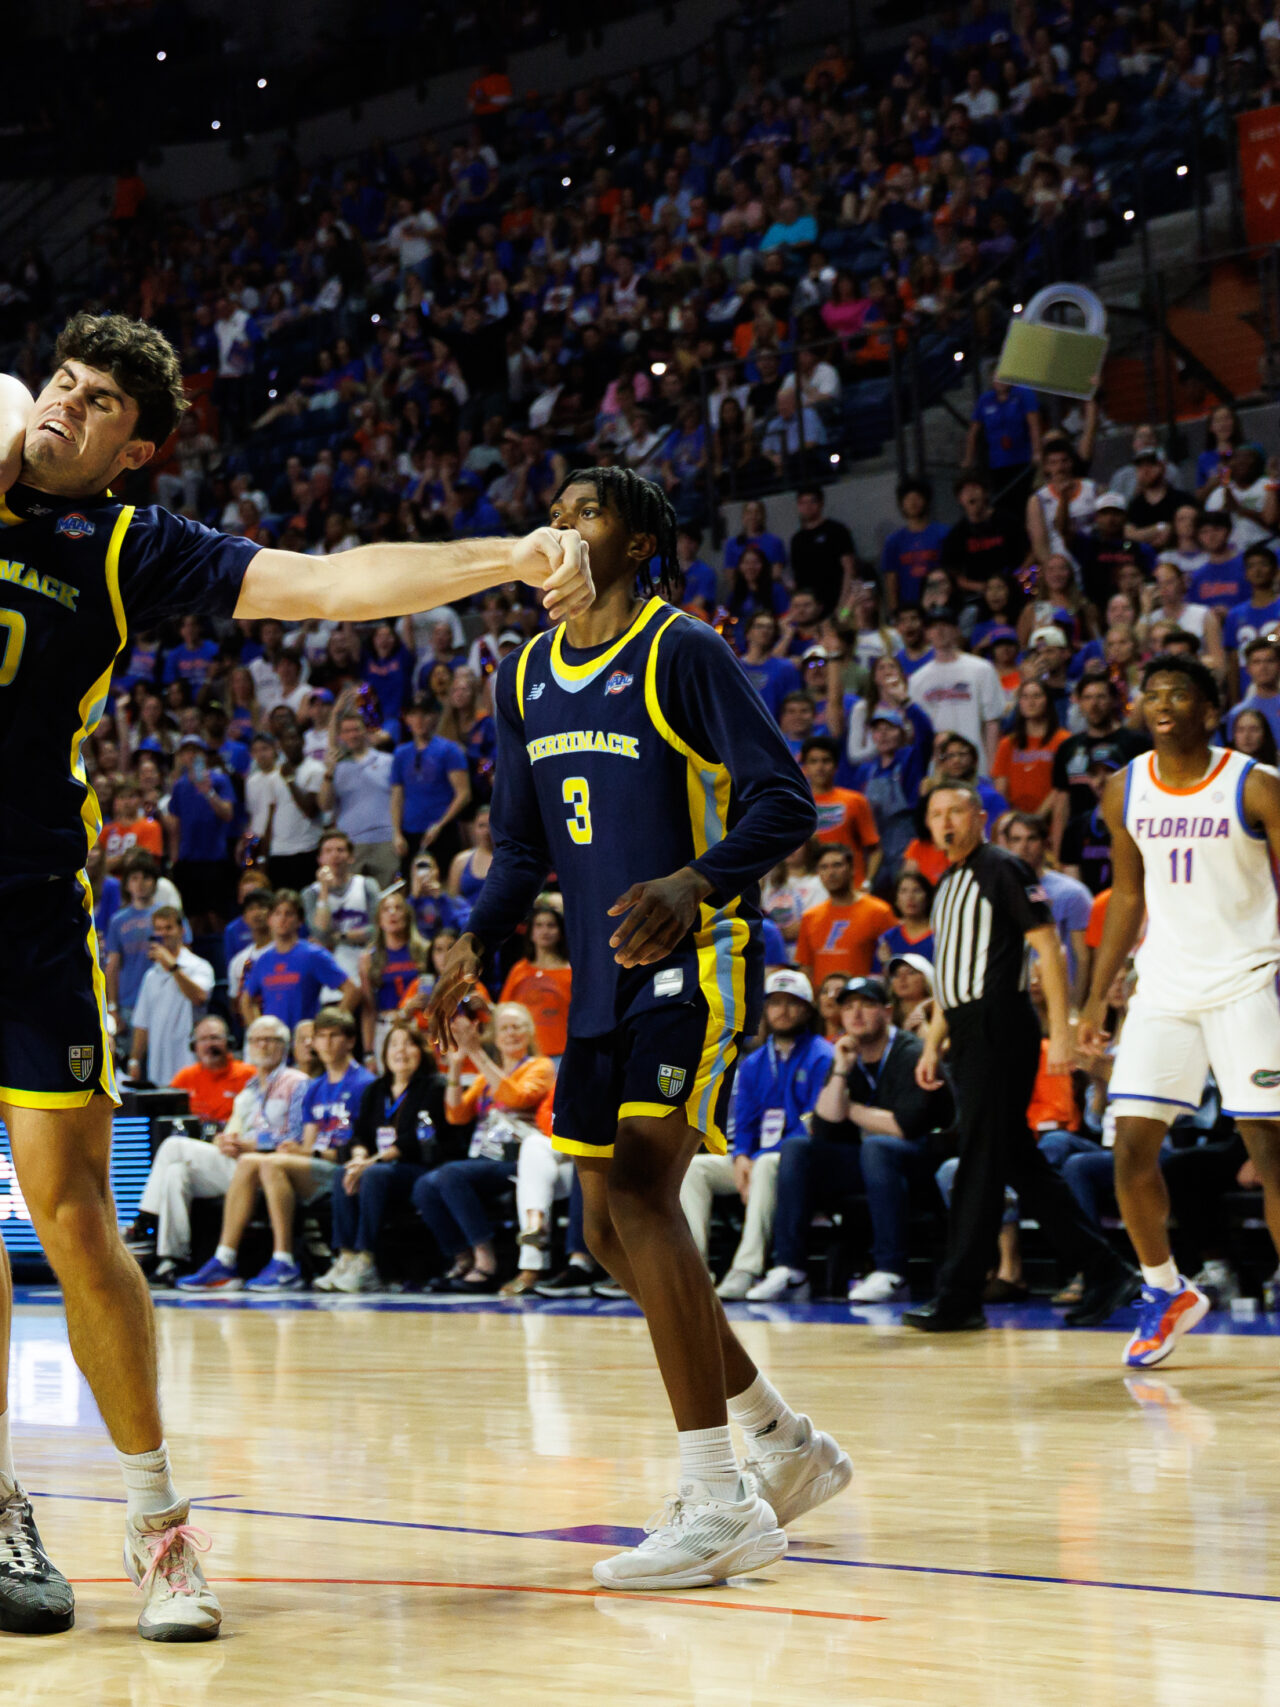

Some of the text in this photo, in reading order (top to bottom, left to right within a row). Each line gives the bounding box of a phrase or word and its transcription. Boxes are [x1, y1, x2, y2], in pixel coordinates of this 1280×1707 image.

[562, 776, 593, 845] 3
[1135, 817, 1230, 840] FLORIDA
[1169, 847, 1194, 884] 11
